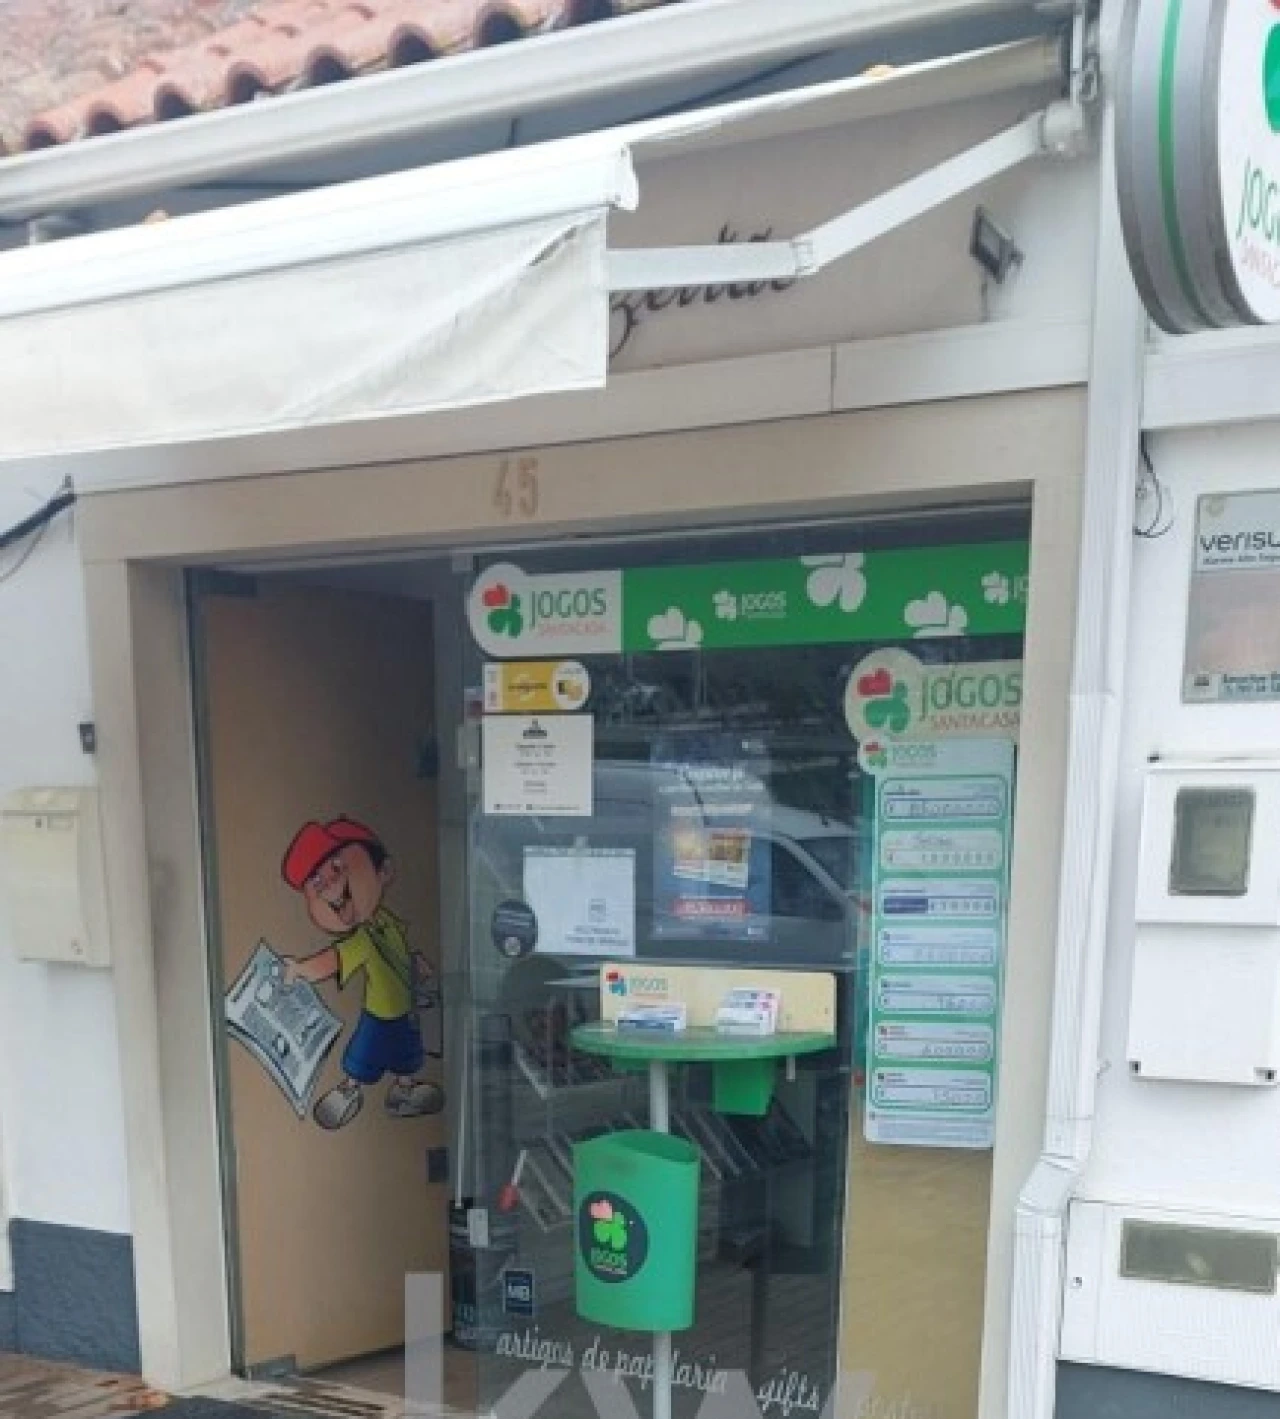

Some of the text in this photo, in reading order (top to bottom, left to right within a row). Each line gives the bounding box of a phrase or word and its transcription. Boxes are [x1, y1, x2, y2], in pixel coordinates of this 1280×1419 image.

[492, 459, 538, 516] 45
[529, 588, 607, 630] JOGOS
[741, 591, 787, 616] JOGOS
[919, 673, 1022, 722] JOGOS
[581, 1334, 611, 1373] de
[613, 1348, 728, 1394] paplaria
[757, 1366, 819, 1417] gifts
